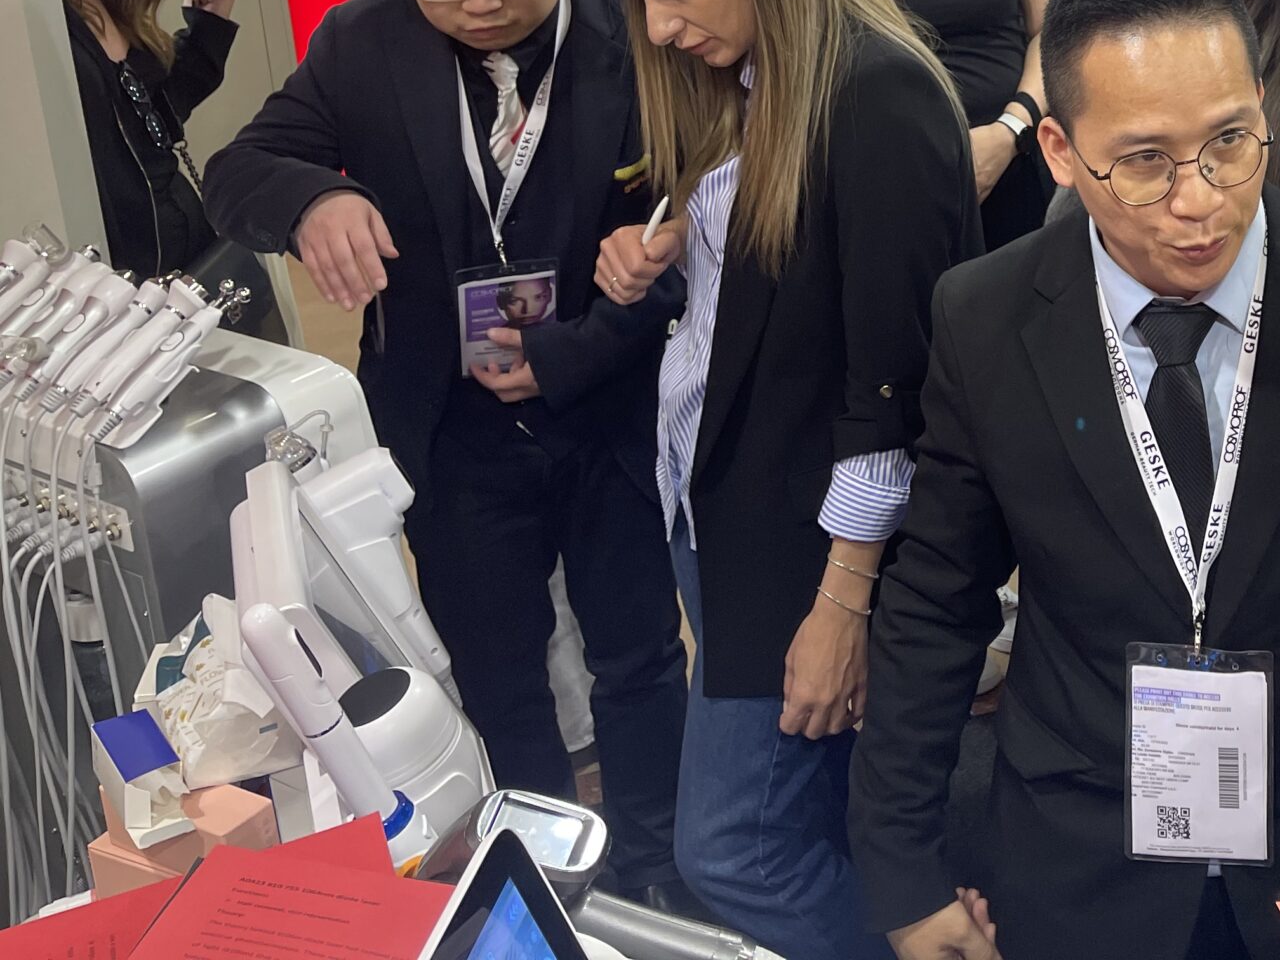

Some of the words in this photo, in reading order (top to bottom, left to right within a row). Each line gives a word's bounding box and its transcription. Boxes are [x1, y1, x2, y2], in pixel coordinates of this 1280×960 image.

[514, 129, 534, 167] GESKE
[1243, 294, 1263, 354] GESKE
[1104, 328, 1138, 399] COSMOPROF
[1223, 384, 1247, 463] COSMOPROF
[1140, 431, 1171, 490] GESKE
[1202, 503, 1224, 563] GESKE
